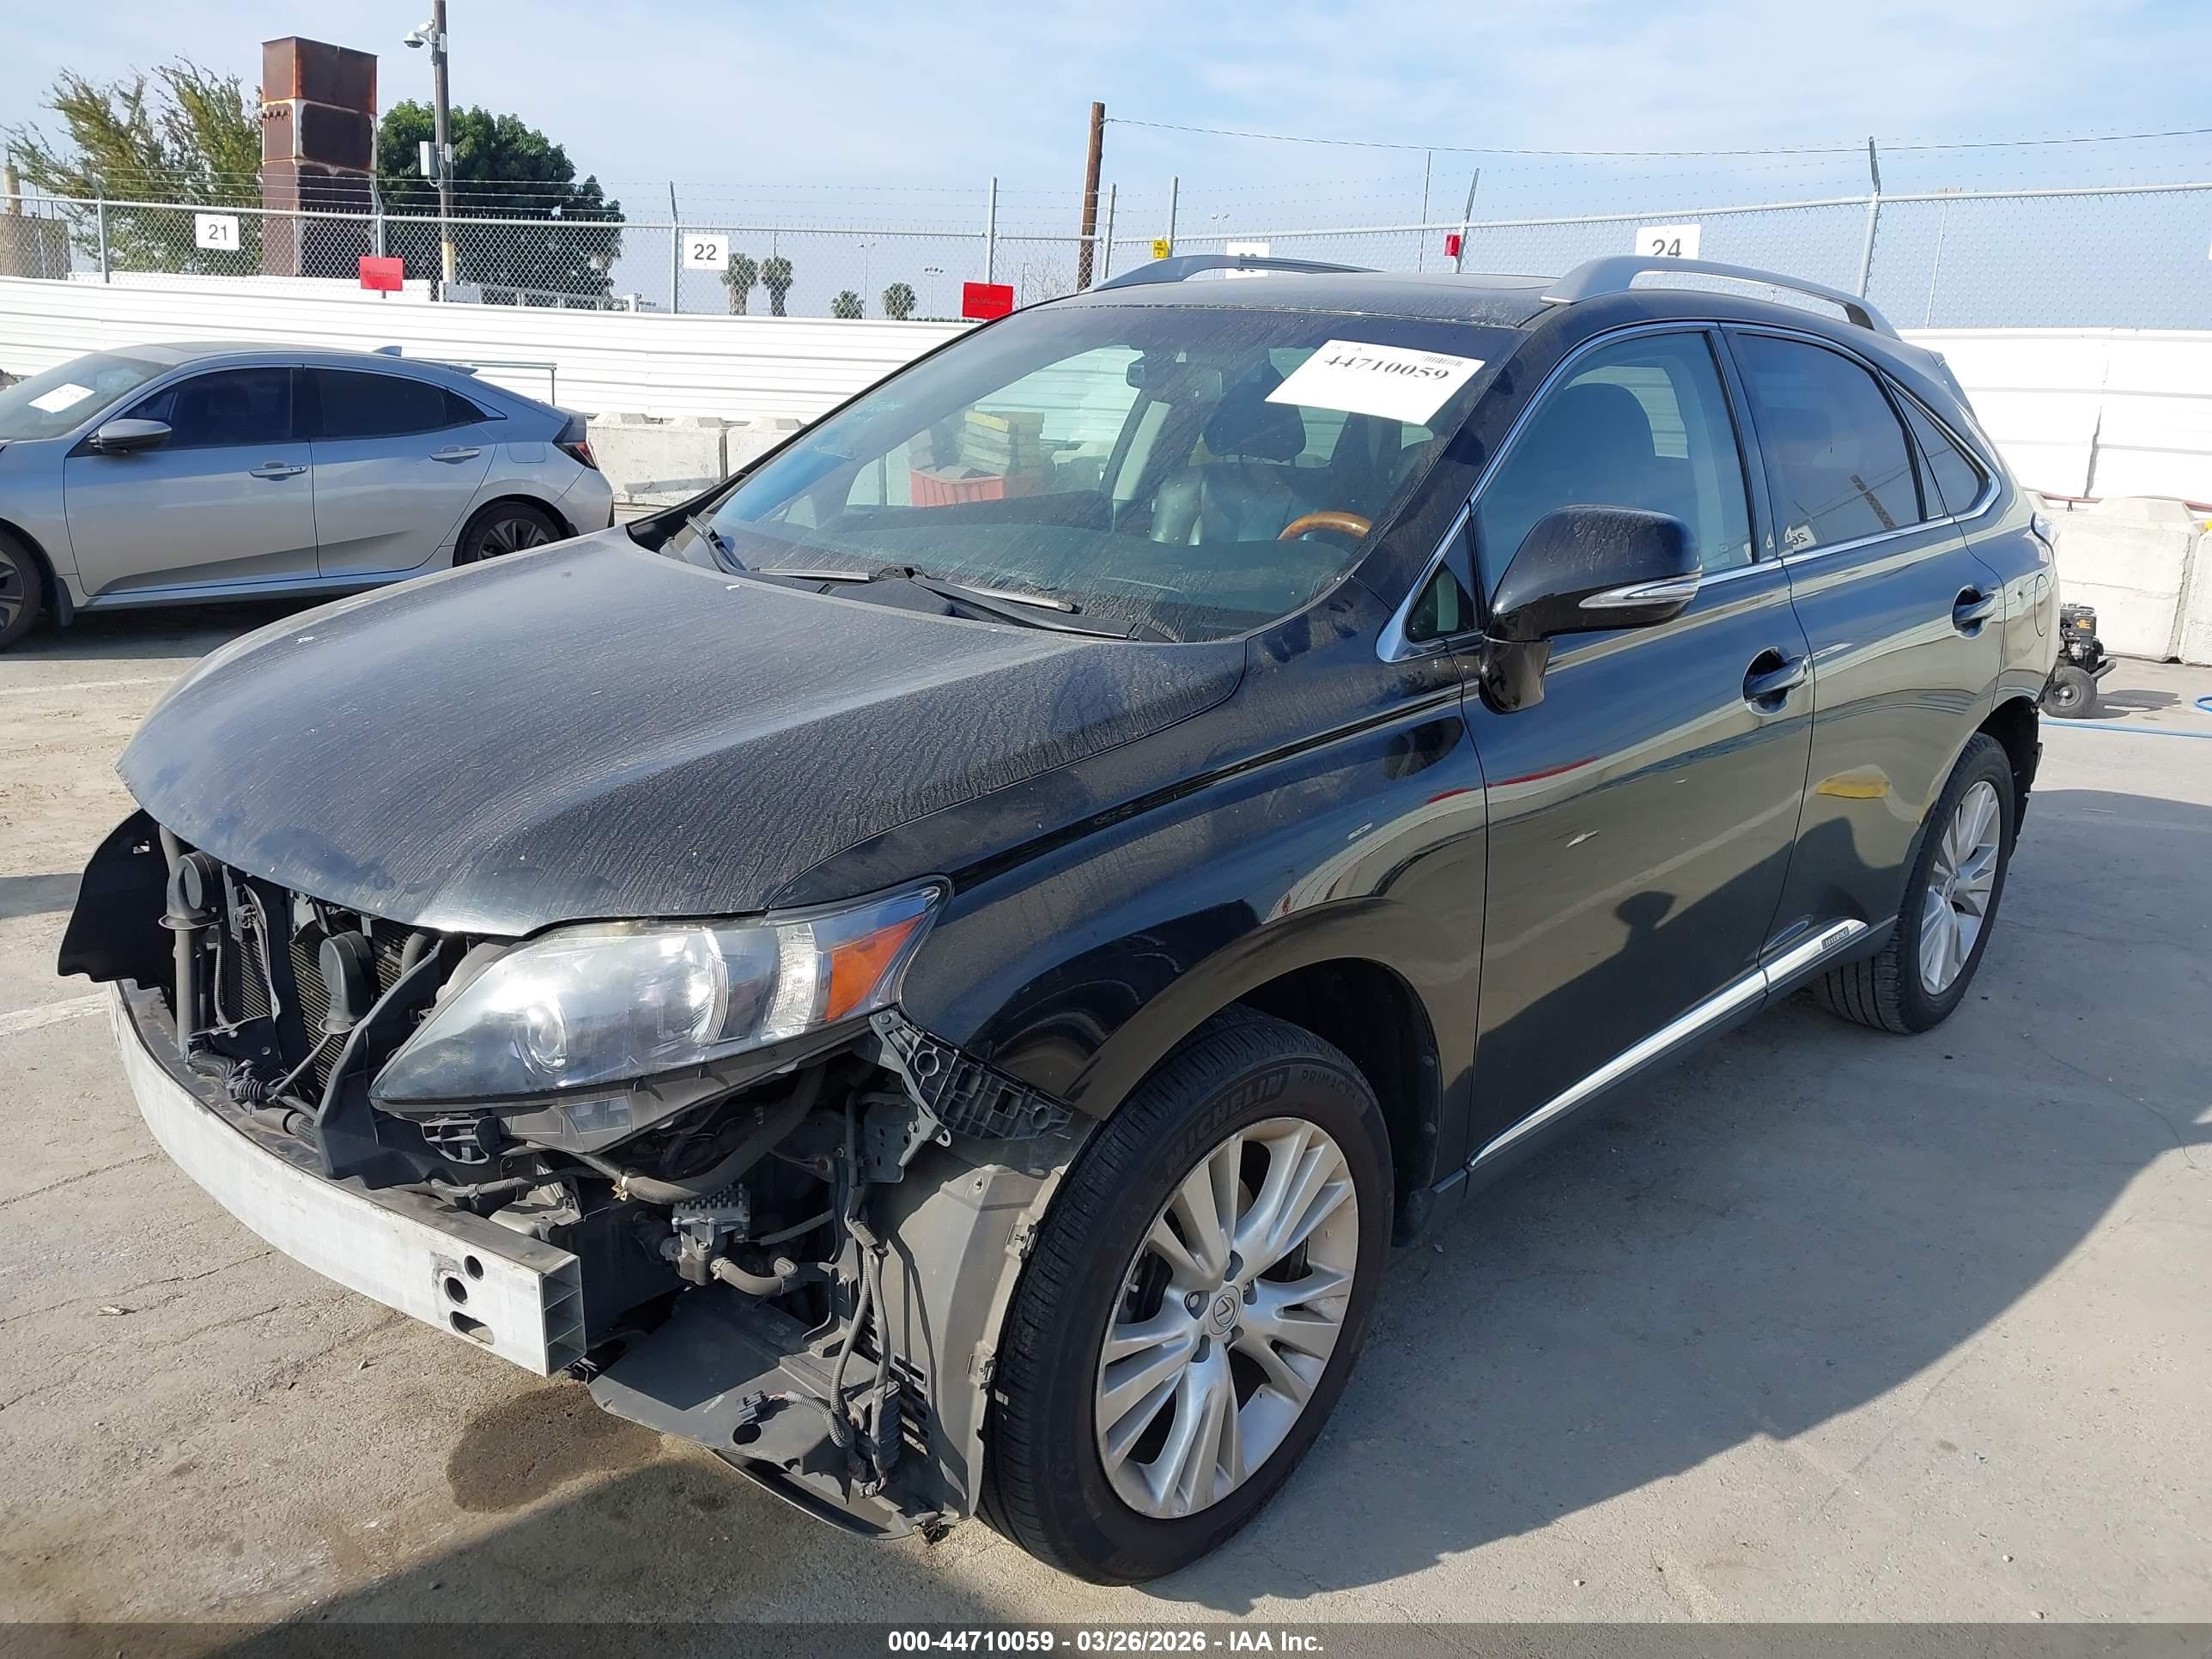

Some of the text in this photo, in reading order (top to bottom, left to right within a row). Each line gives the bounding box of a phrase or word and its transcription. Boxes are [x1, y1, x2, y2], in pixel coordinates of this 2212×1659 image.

[209, 223, 227, 240] 21
[694, 243, 716, 260] 22
[1652, 238, 1681, 257] 24
[1323, 354, 1449, 381] 44710059
[1825, 929, 1848, 946] HYBRID
[1164, 1073, 1285, 1176] MICHELIN
